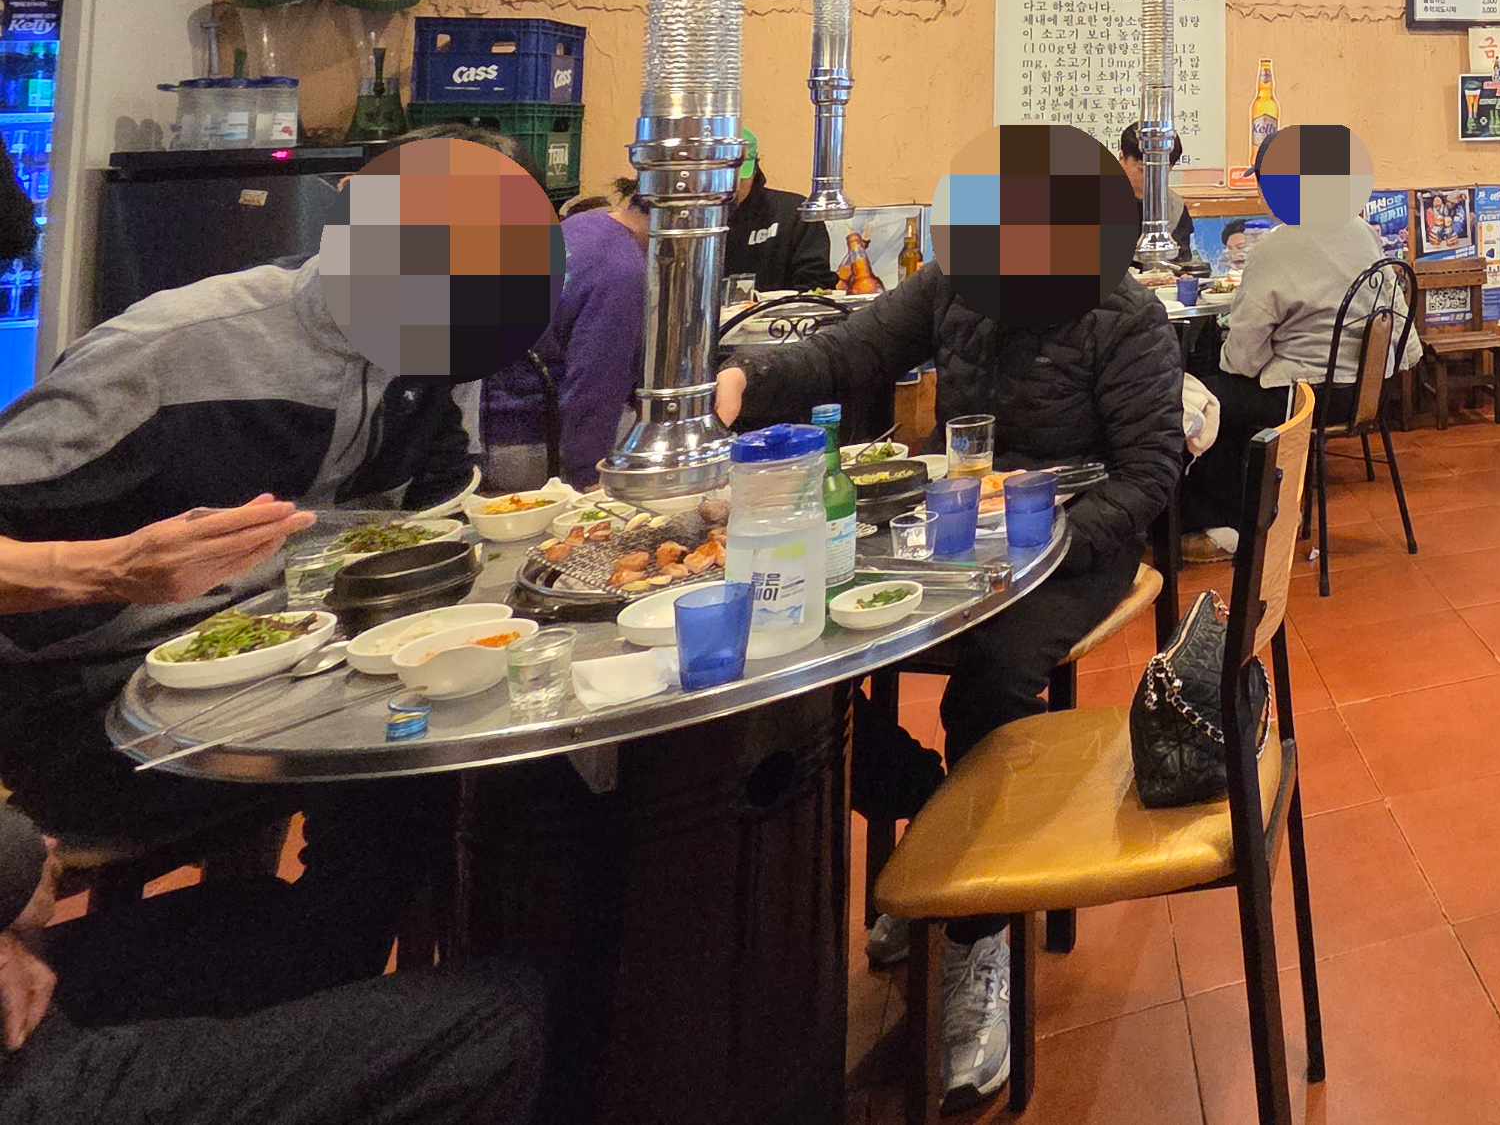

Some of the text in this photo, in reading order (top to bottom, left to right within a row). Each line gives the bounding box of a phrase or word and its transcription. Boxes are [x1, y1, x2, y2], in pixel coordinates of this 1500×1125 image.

[1024, 1, 1115, 14] 다고 하였습니다.
[1023, 14, 1057, 26] 체내에
[1063, 14, 1098, 26] 필요한
[8, 19, 56, 35] Kelly
[1022, 28, 1141, 41] 이 소고기 보다 높습
[1023, 42, 1077, 56] (100g당
[1054, 57, 1091, 68] 소고기
[1100, 58, 1141, 70] 19mg)
[452, 64, 499, 84] Cass
[554, 69, 572, 89] Cass
[1022, 71, 1034, 82] 이
[1042, 71, 1091, 83] 함유되어
[1097, 72, 1131, 83] 소화가
[1022, 85, 1033, 96] 화
[1041, 85, 1106, 97] 지방산으로
[1173, 84, 1200, 96] 시는
[1022, 98, 1141, 111] 여성분에게도 좋습니
[1103, 112, 1139, 123] 알콜분
[1252, 123, 1276, 134] Kell
